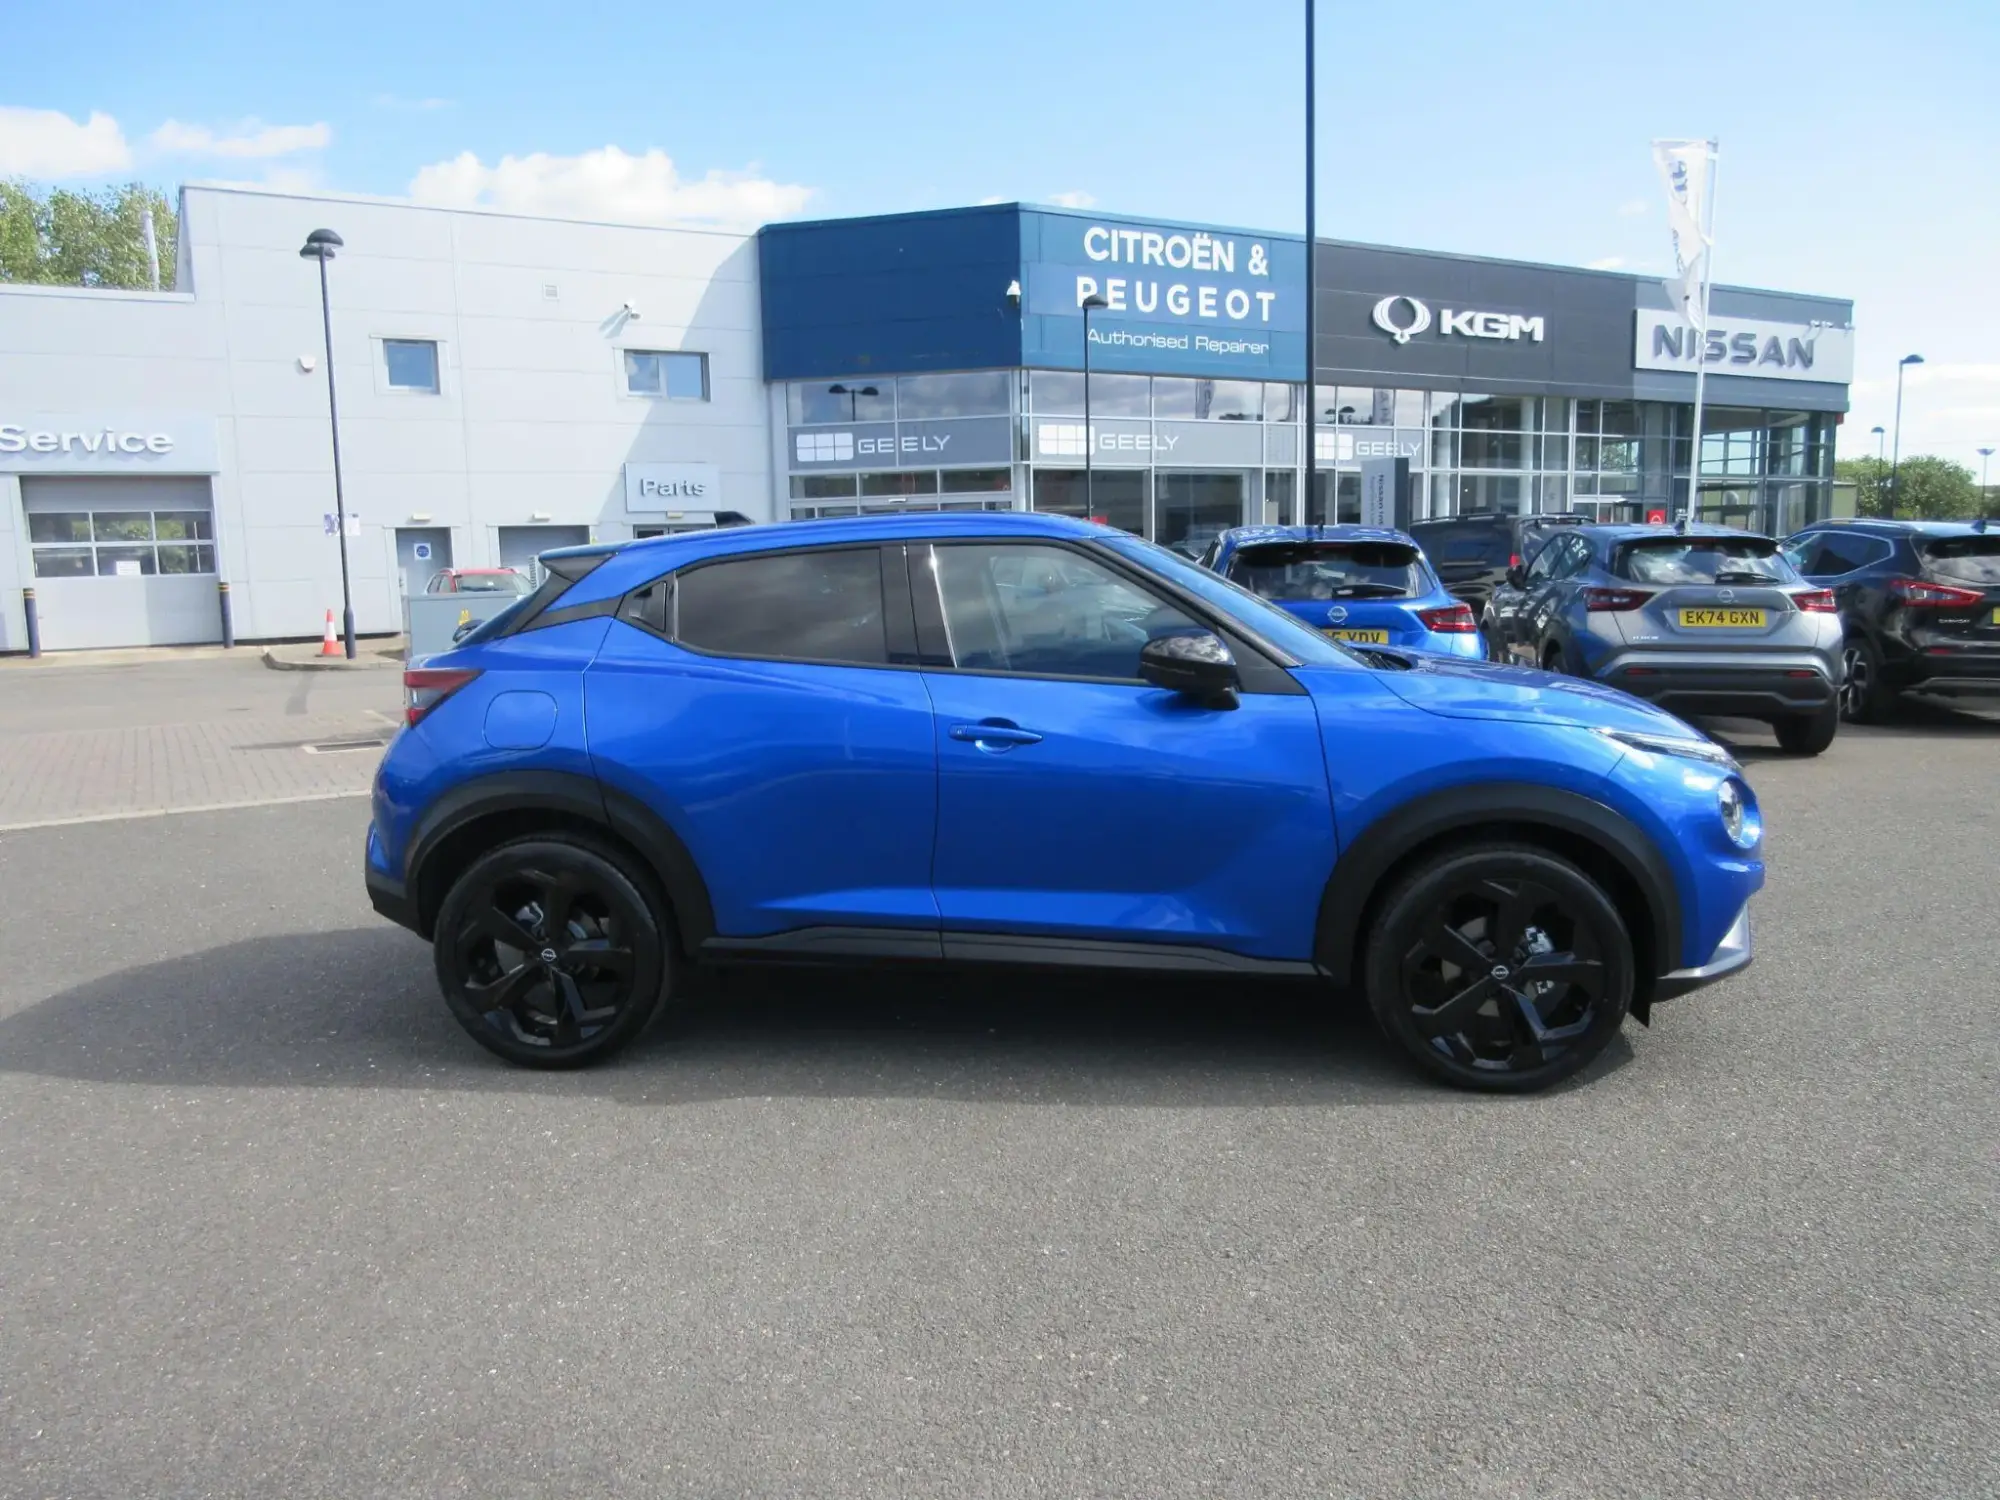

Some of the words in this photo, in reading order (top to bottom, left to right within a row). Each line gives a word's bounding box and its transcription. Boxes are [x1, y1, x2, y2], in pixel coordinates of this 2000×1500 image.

[1083, 226, 1235, 273] CITROËN
[1247, 243, 1269, 276] &
[1076, 276, 1276, 322] PEUGEOT
[1440, 308, 1545, 342] KGM
[1087, 328, 1189, 350] Authorised
[1195, 335, 1269, 356] Repairer
[1652, 323, 1815, 370] NISSAN
[0, 423, 174, 454] Service
[857, 434, 951, 454] GEELY
[1099, 432, 1180, 451] GEELY
[1355, 440, 1422, 457] GEELY
[640, 478, 707, 497] Parts
[1685, 610, 1726, 625] EK74
[1728, 611, 1760, 625] GXN
